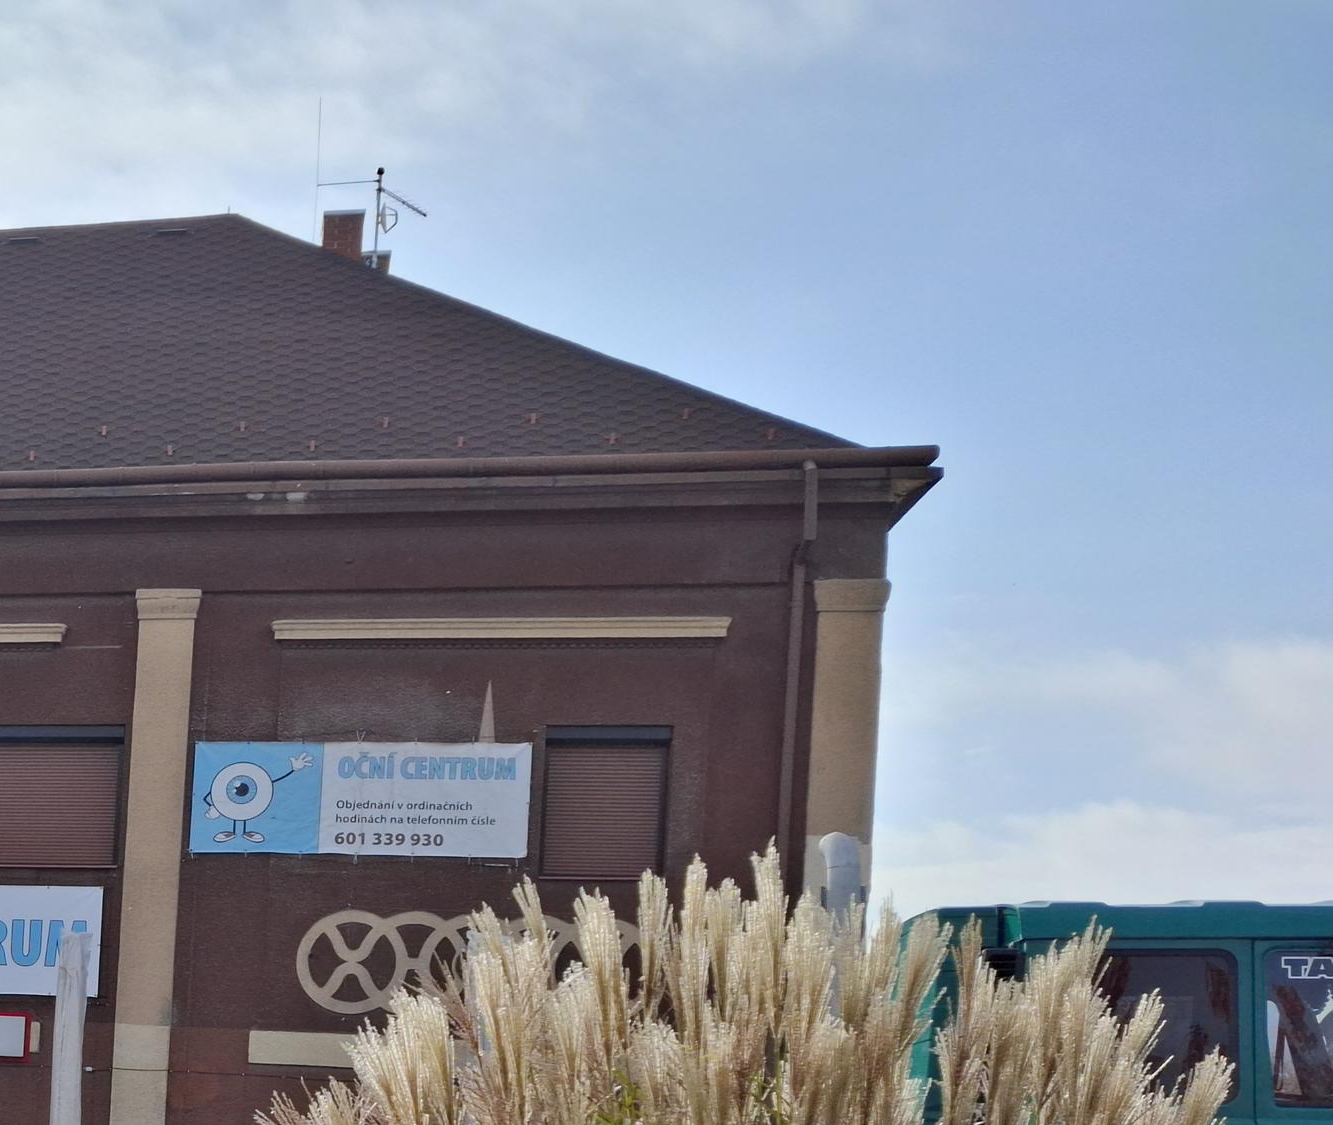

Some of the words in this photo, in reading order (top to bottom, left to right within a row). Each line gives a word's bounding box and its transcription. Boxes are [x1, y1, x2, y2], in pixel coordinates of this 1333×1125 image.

[337, 752, 397, 780] OČNÍ
[400, 756, 516, 781] CENTRUM
[336, 799, 394, 812] Objednání
[406, 800, 473, 811] ordinačních
[335, 814, 386, 824] hodinách
[390, 816, 403, 824] na
[334, 832, 366, 845] 601
[372, 832, 405, 846] 339
[410, 833, 444, 847] 930
[1281, 956, 1333, 979] TA
